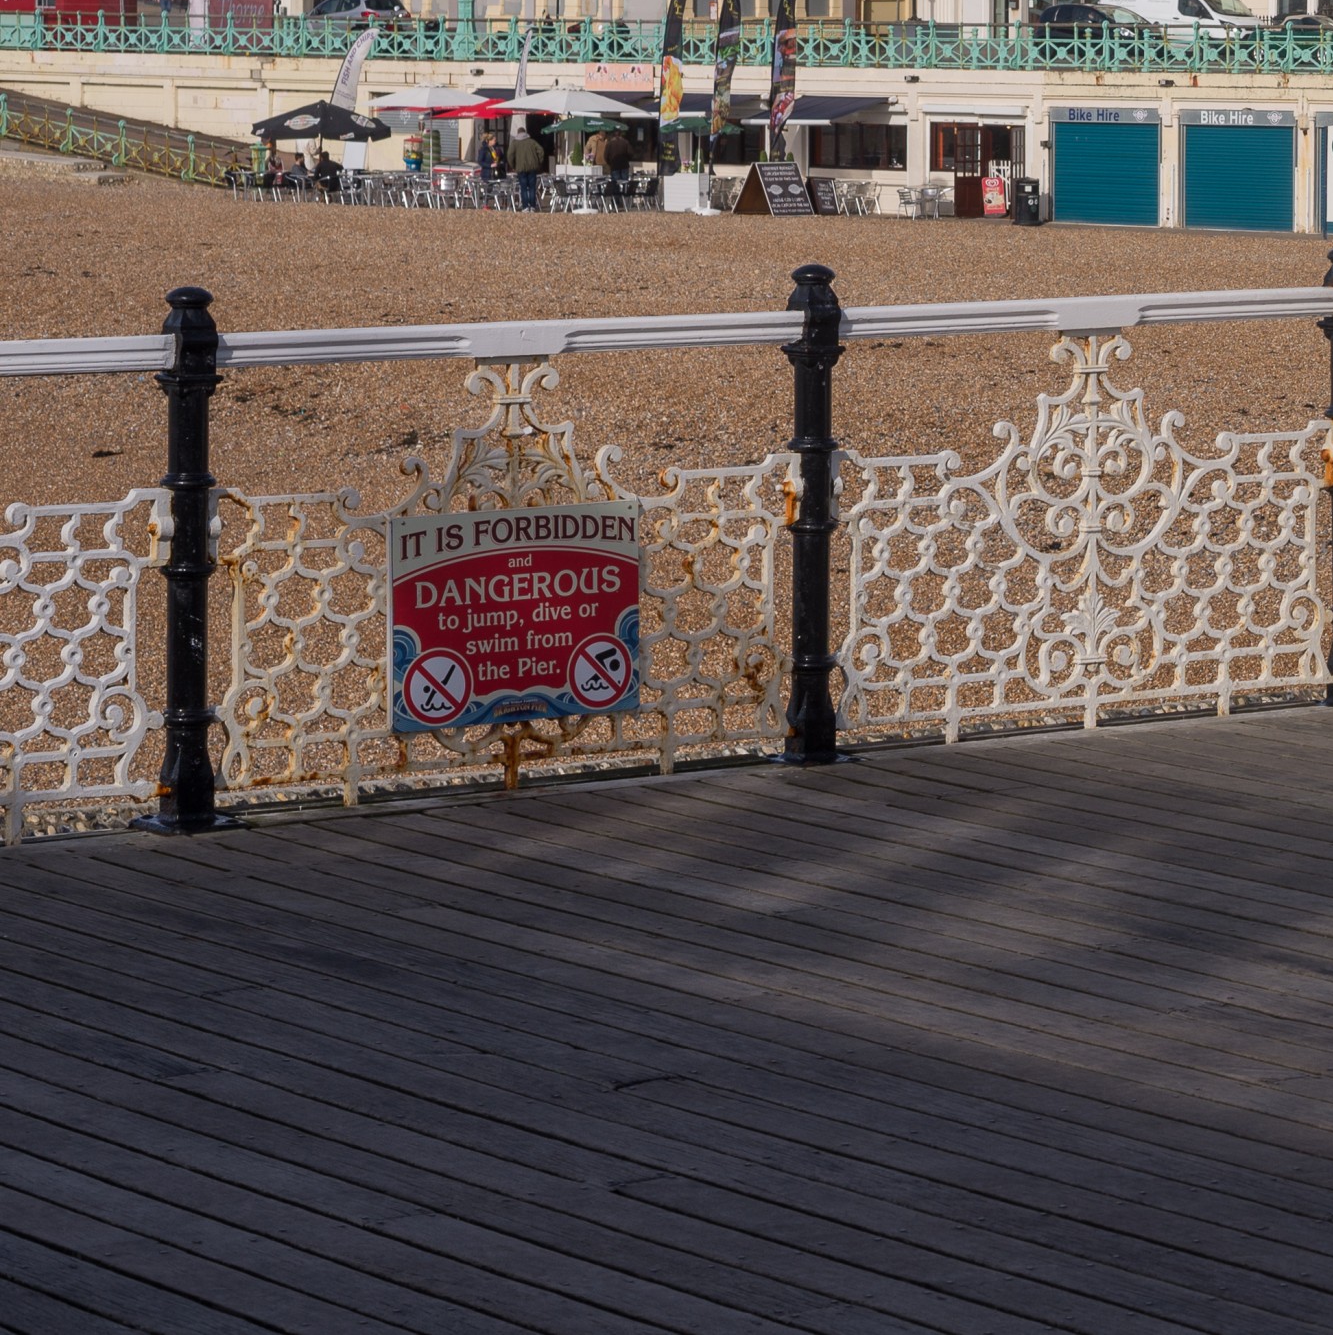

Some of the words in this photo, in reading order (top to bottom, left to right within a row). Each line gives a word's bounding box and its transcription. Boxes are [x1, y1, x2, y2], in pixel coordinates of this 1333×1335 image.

[341, 66, 351, 87] FISH
[347, 48, 358, 66] AND
[356, 32, 376, 48] CHIPS
[1068, 108, 1092, 121] Bike
[1096, 108, 1120, 122] Hire
[1200, 110, 1225, 125] Bike
[1229, 111, 1254, 125] Hire
[400, 530, 428, 561] IT
[435, 524, 464, 553] IS
[473, 514, 636, 547] FORBIDDEN
[508, 554, 532, 568] and
[414, 565, 621, 609] DANGEROUS
[438, 612, 459, 631] to
[462, 608, 524, 633] jump,
[532, 602, 572, 622] dive
[578, 601, 599, 617] or
[466, 633, 519, 655] swim
[526, 630, 573, 650] from
[477, 661, 510, 681] the
[518, 657, 561, 678] Pier.
